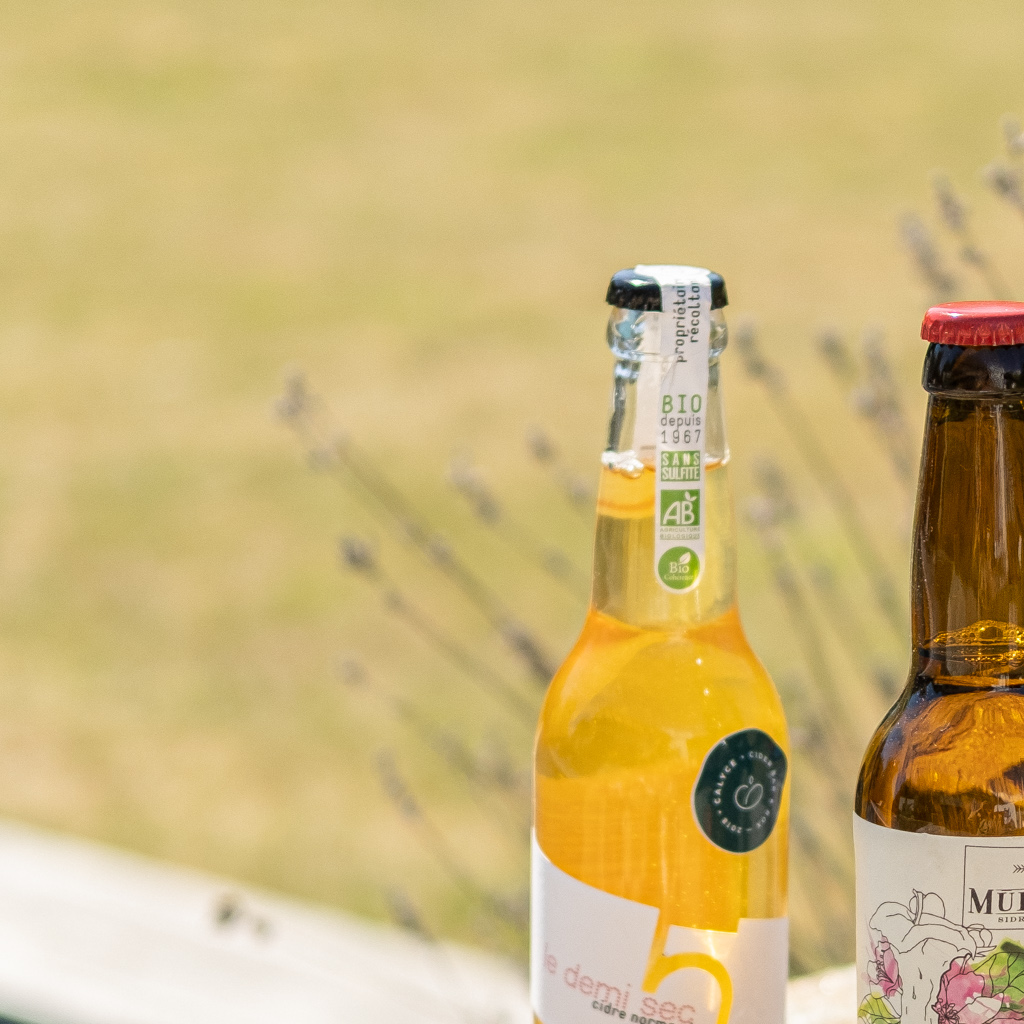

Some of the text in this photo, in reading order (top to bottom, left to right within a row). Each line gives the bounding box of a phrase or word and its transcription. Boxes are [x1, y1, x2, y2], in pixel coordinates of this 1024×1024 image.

[662, 394, 702, 414] BIO
[660, 413, 702, 429] depuis
[661, 429, 701, 444] 1967
[662, 452, 700, 466] SANS
[662, 466, 700, 480] SULFITE
[662, 500, 695, 525] AB
[669, 561, 690, 574] Bio
[563, 963, 631, 1011] demi
[639, 996, 696, 1024] sec
[592, 1000, 627, 1020] cidre
